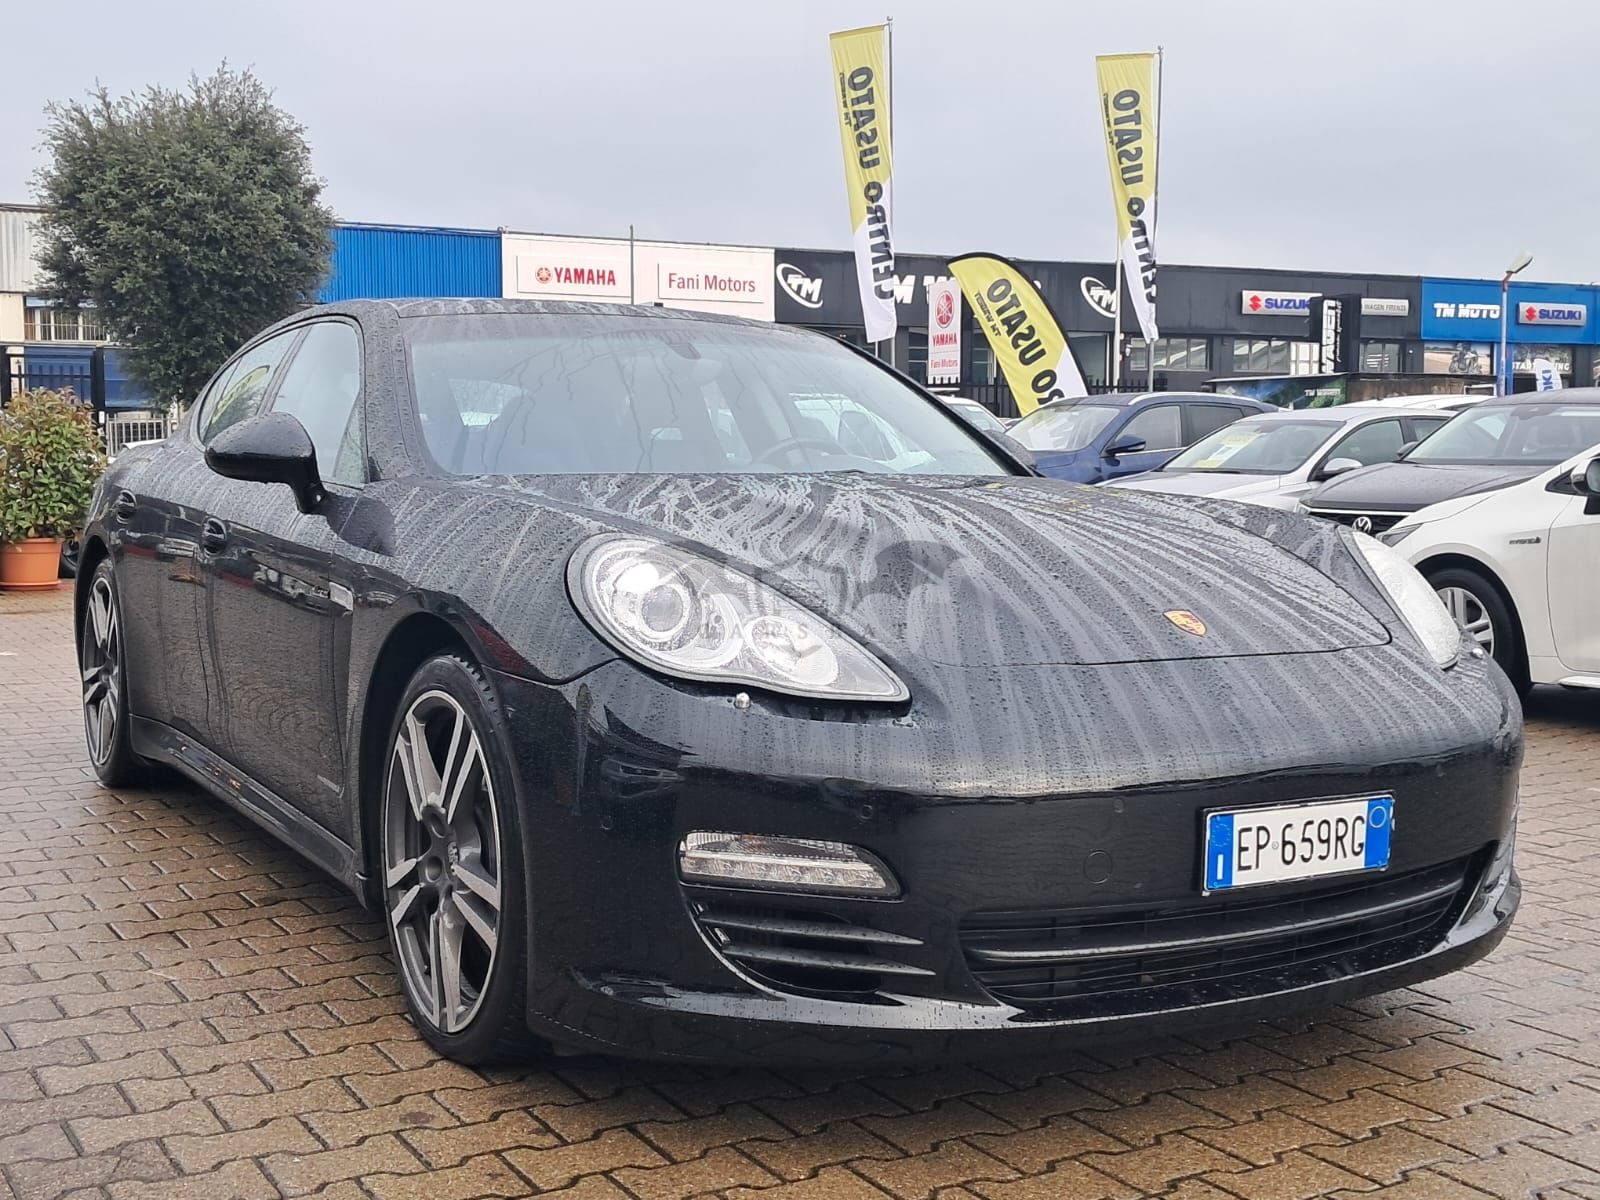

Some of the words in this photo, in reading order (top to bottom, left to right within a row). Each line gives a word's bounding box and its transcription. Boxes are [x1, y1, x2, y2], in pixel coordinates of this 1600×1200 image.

[553, 266, 617, 287] YAMAHA
[668, 273, 701, 292] Fani
[704, 275, 757, 294] Motors
[1264, 297, 1311, 310] SUZUK
[1433, 302, 1456, 319] TM
[1458, 303, 1500, 319] MOTO
[1538, 308, 1582, 321] SUZUKI
[932, 332, 958, 347] YAMAHA
[1216, 853, 1224, 881] I
[1237, 825, 1271, 872] EP
[1281, 815, 1366, 866] 659RG
